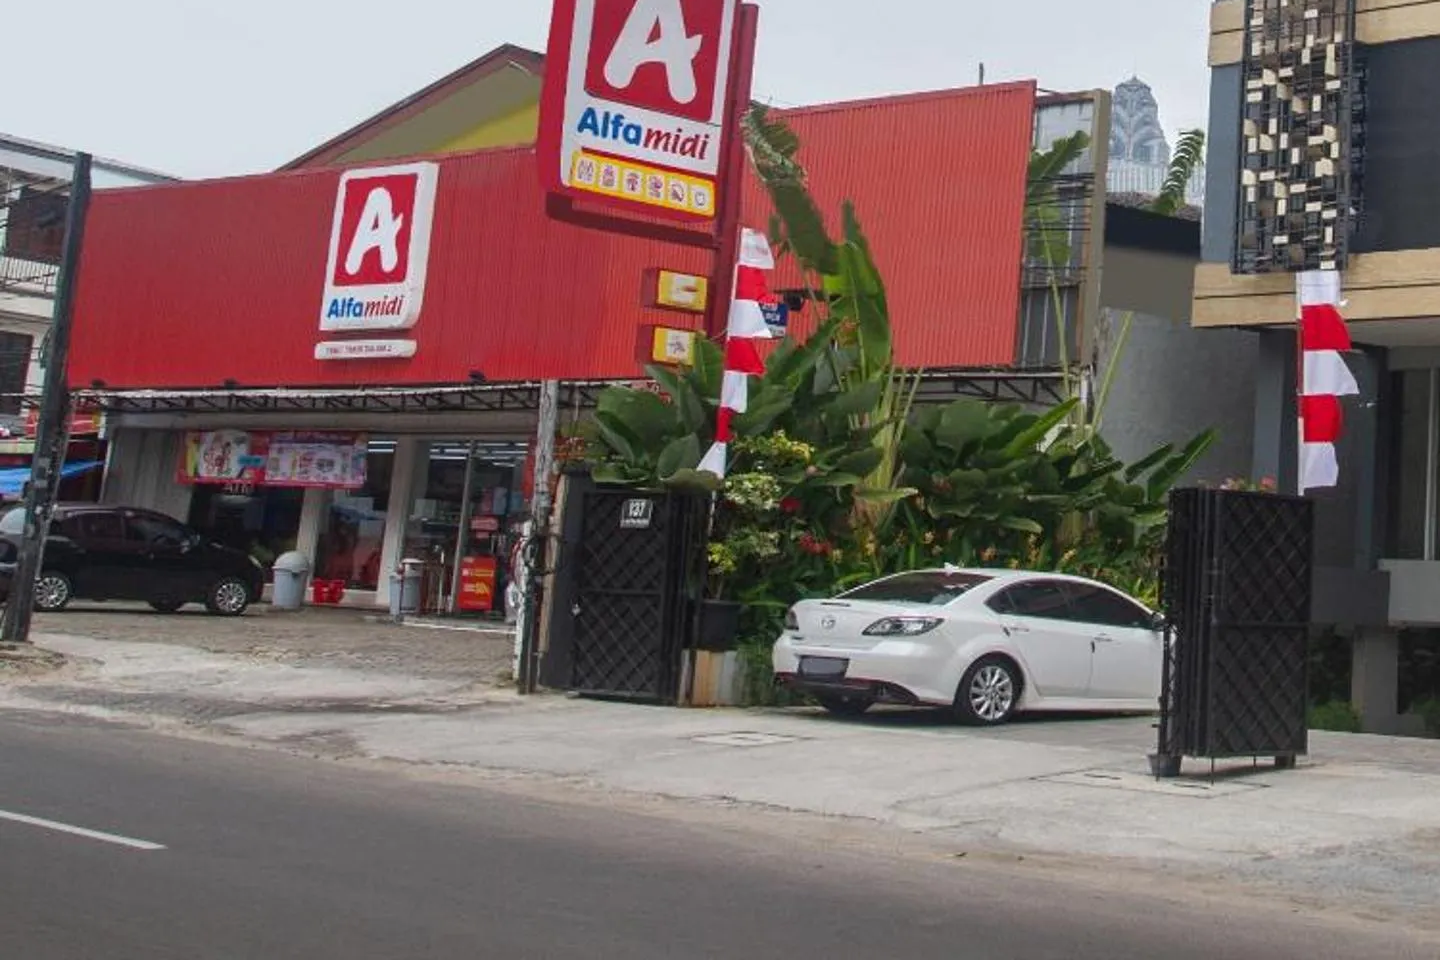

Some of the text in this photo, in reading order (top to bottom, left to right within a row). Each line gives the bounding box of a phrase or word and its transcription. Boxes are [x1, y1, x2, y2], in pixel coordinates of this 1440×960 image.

[577, 107, 710, 160] Alfamidi
[345, 187, 404, 275] A
[327, 295, 405, 318] Alfamidi
